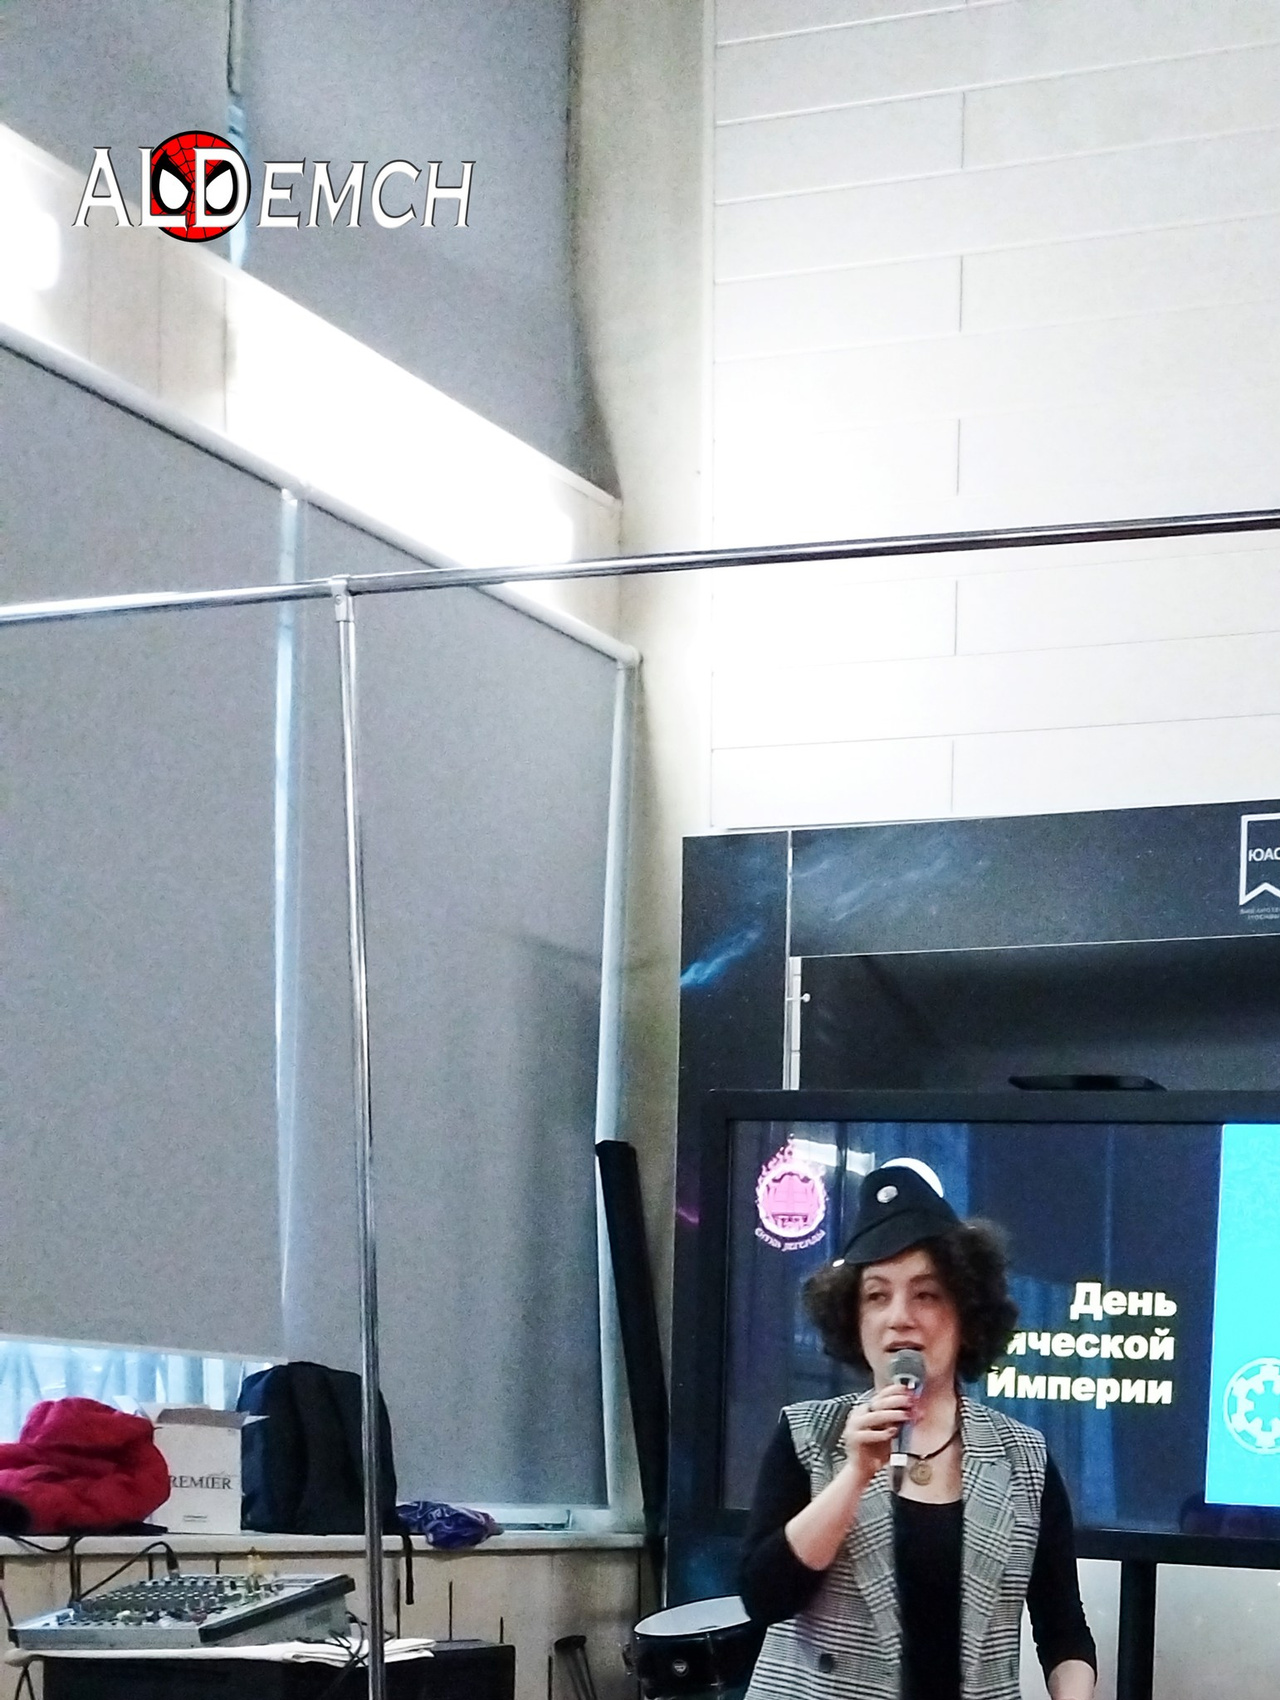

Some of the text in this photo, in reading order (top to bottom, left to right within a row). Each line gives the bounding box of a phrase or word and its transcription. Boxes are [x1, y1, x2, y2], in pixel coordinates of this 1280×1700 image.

[1069, 1281, 1178, 1321] День
[1006, 1327, 1175, 1361] ической
[986, 1365, 1173, 1410] Империи
